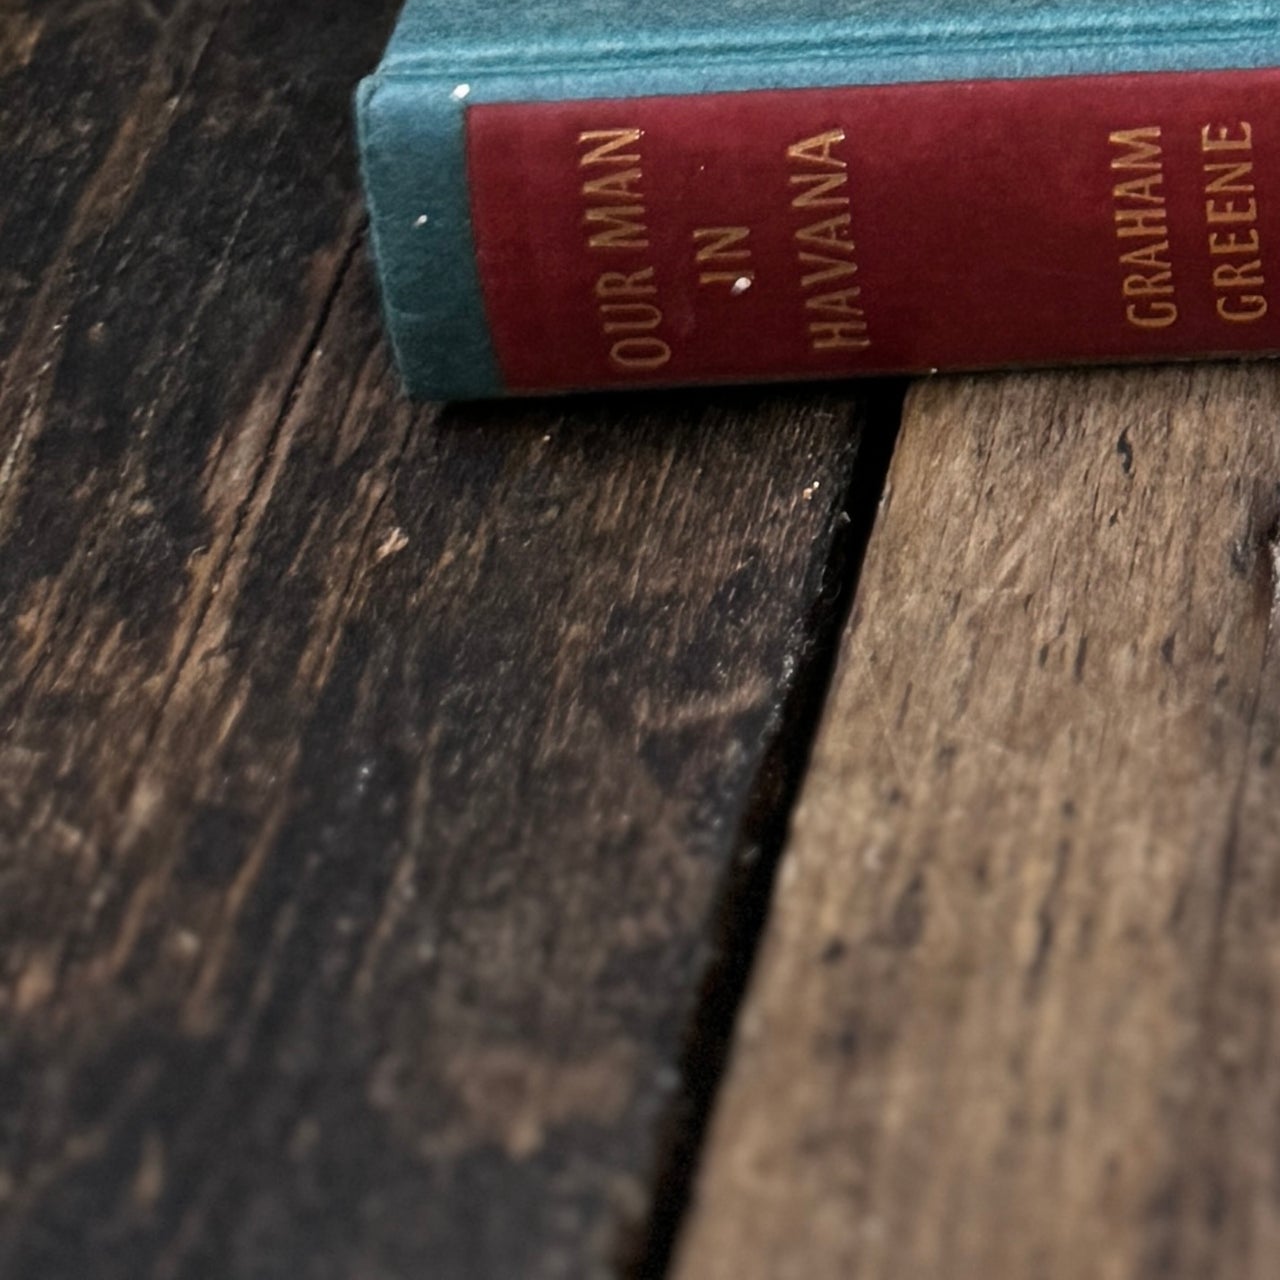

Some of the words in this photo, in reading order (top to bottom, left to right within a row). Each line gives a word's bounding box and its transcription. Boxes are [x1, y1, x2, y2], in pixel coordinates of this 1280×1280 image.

[577, 127, 650, 248] MAN
[693, 225, 753, 286] IN
[787, 127, 870, 350] HAVANA
[1108, 125, 1178, 329] GRAHAM
[1201, 120, 1269, 322] GREENE
[596, 265, 672, 369] OUR
